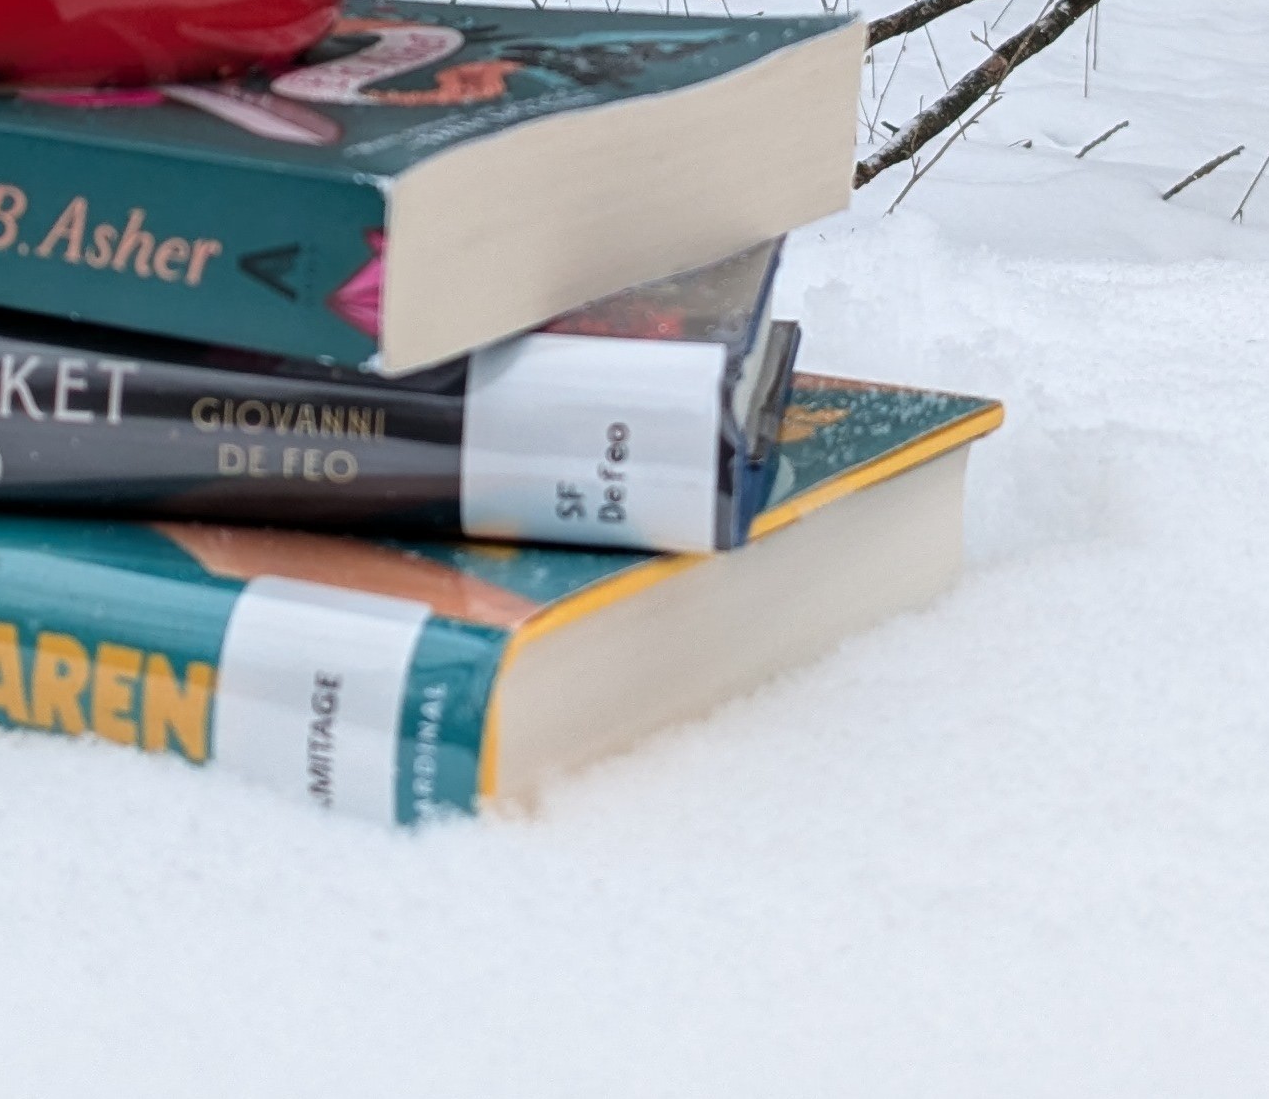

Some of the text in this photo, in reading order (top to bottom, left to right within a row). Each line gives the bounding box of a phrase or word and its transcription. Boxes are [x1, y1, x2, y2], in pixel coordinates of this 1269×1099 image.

[192, 396, 386, 442] GIOVANNI
[218, 443, 358, 485] DE FEO
[598, 422, 630, 524] Defeo
[556, 483, 586, 522] SF
